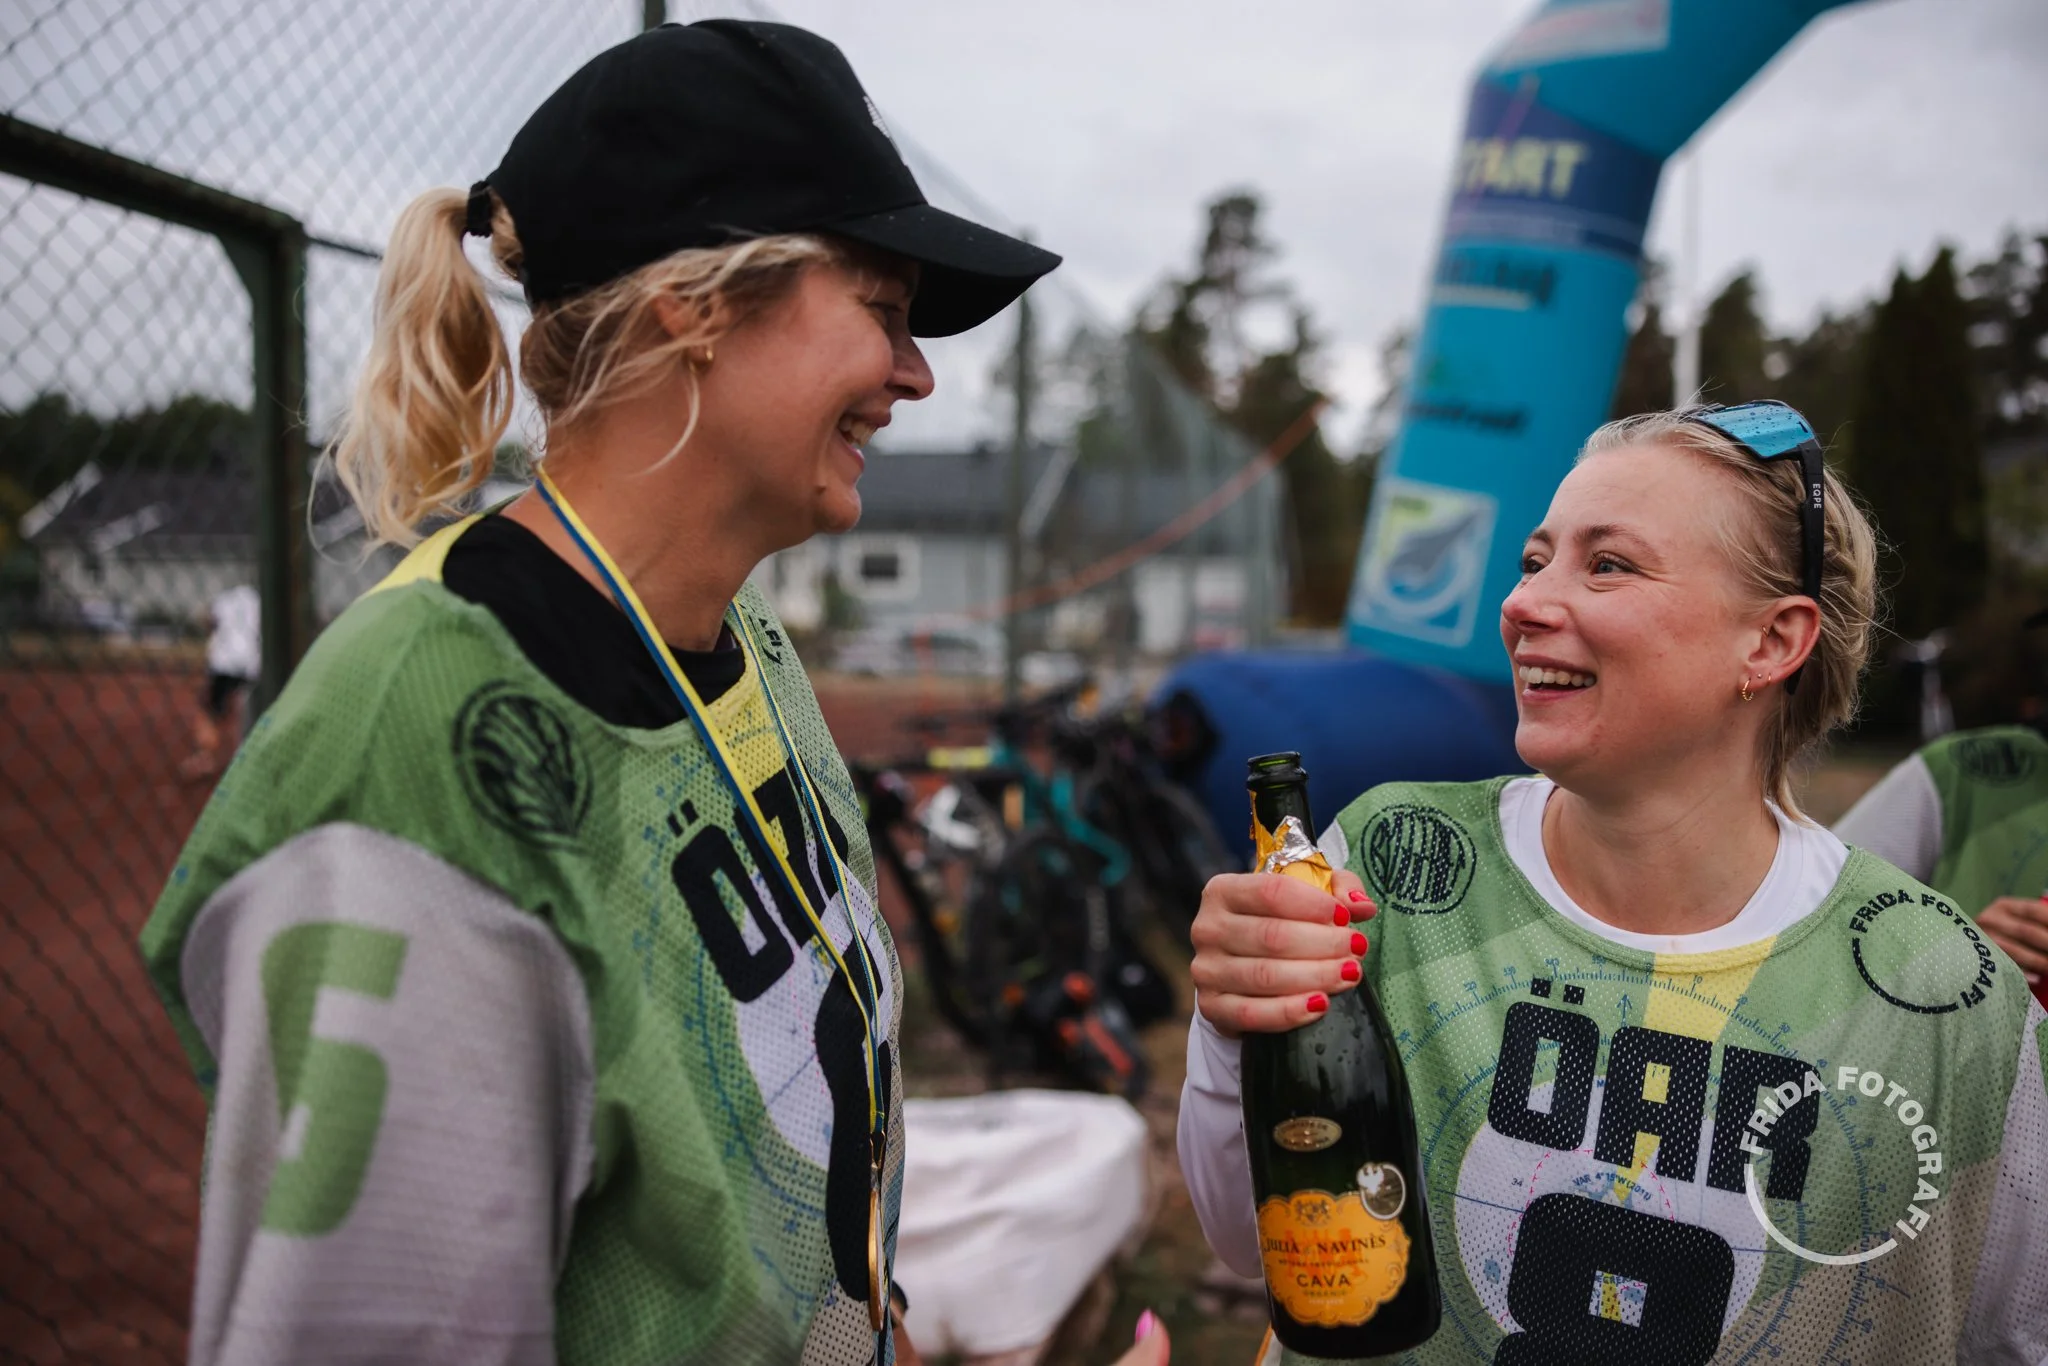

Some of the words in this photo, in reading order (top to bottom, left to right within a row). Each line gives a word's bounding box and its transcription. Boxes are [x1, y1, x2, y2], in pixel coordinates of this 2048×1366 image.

[1453, 136, 1589, 198] TART
[1812, 483, 1822, 509] EQPE
[1849, 889, 1915, 934] FRIDA
[1920, 893, 1997, 1009] FOTOGRAFI
[1488, 977, 1820, 1202] ÖAR
[1511, 1177, 1523, 1187] 34
[1572, 1174, 1591, 1186] VAR
[1316, 1232, 1386, 1254] NAVINÈS
[1296, 1273, 1351, 1288] CAVA
